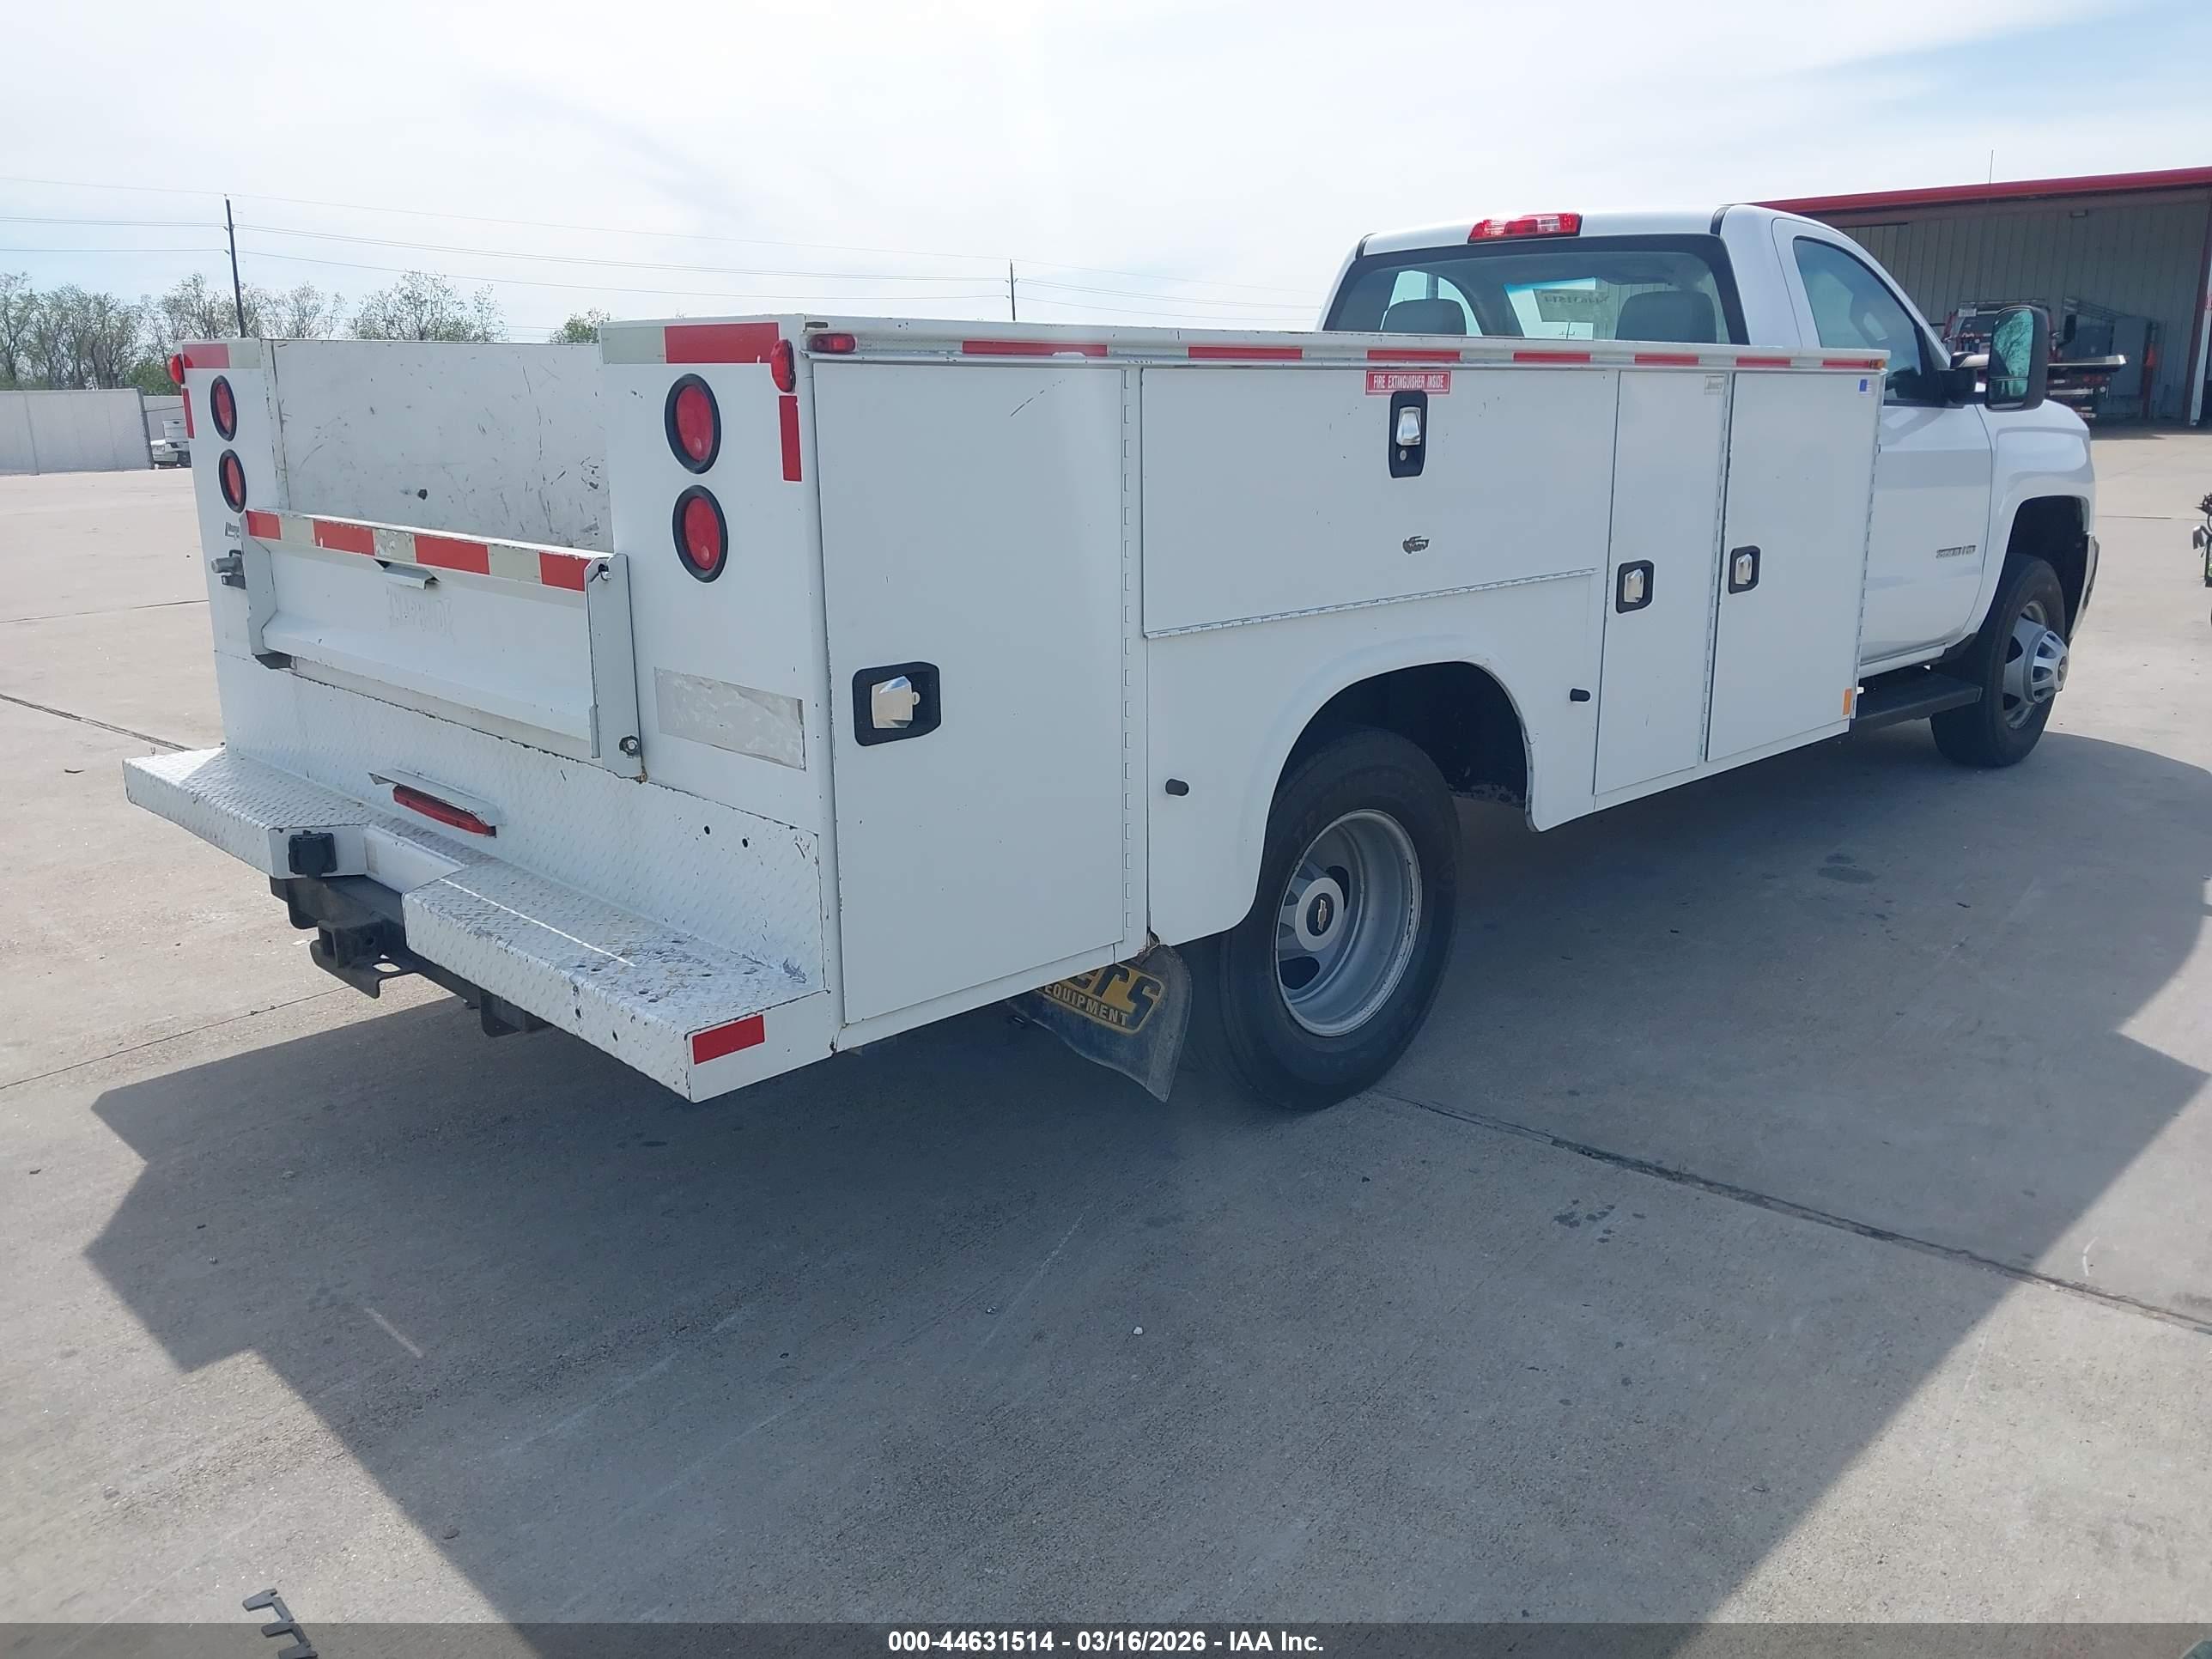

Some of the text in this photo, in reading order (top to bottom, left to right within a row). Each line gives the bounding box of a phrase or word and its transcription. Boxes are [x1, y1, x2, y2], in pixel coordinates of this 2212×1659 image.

[1373, 374, 1444, 389] FIRE EXTINGUISHER INSIDE
[1044, 983, 1128, 1027] EQUIPMENT
